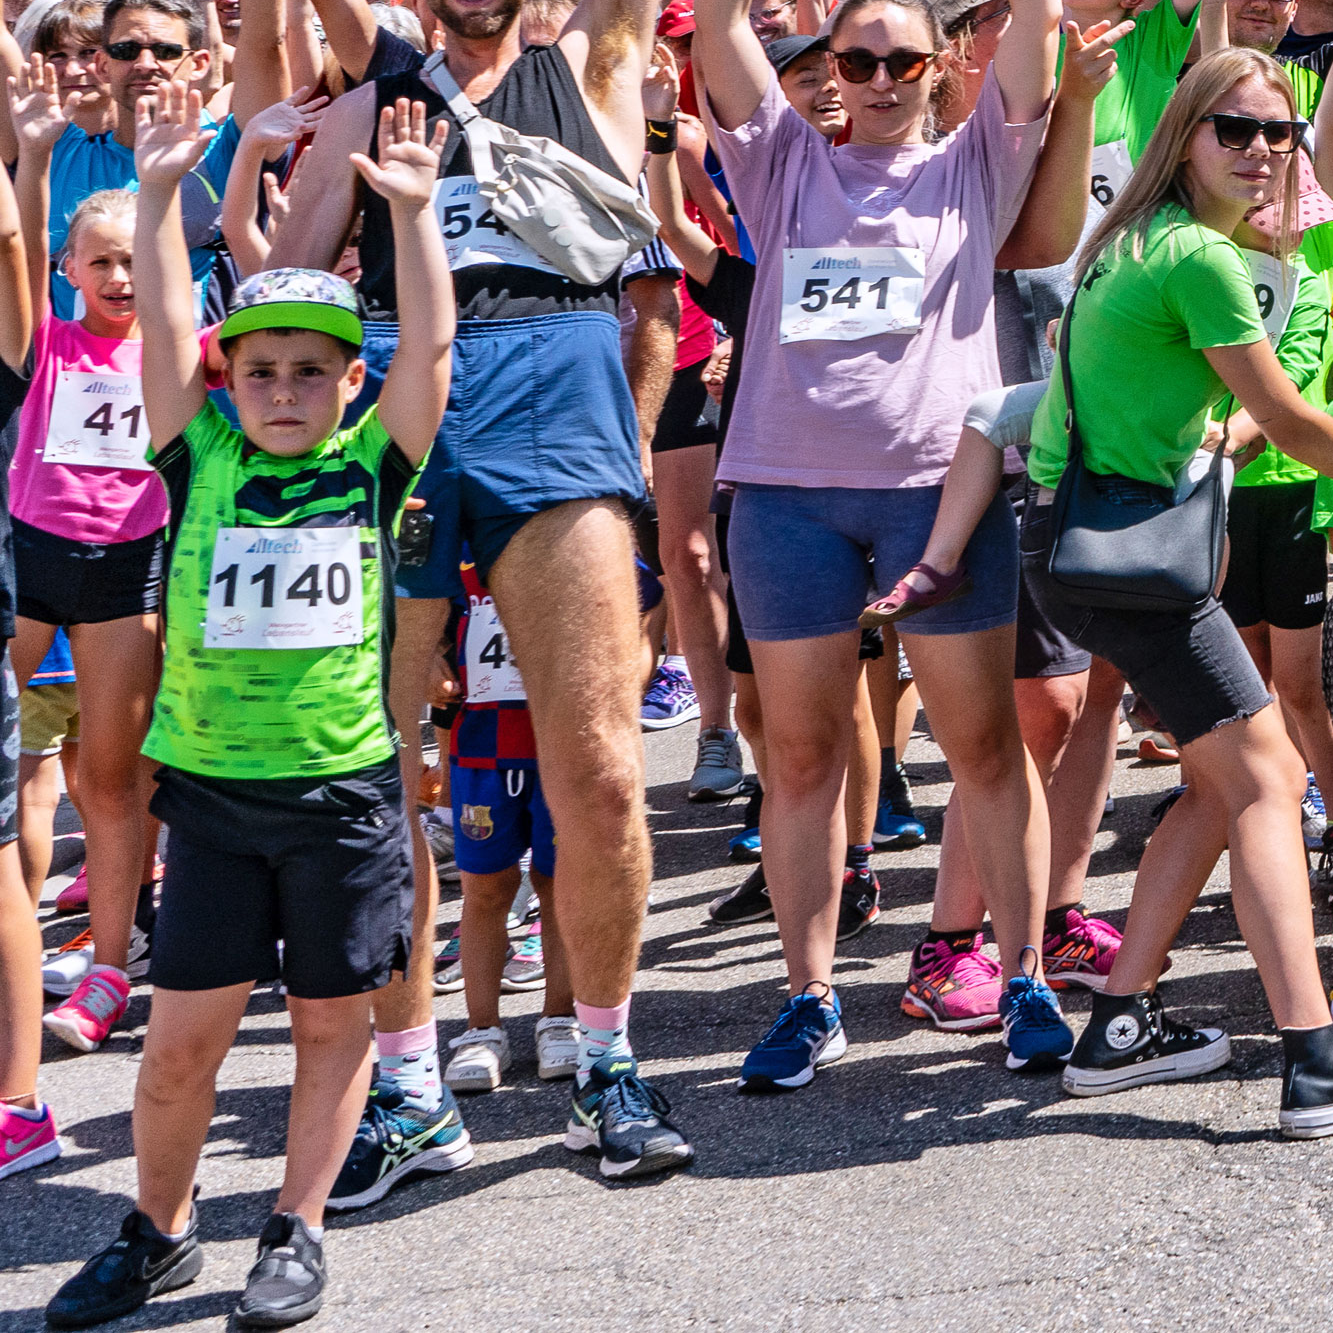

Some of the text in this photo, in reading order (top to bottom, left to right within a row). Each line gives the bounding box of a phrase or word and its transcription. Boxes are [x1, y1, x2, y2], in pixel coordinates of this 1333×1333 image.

[811, 256, 862, 270] Alltech
[800, 276, 891, 313] 541
[81, 381, 132, 396] Alltech
[83, 402, 144, 439] 41
[245, 538, 303, 554] Alltech
[214, 561, 351, 608] 1140
